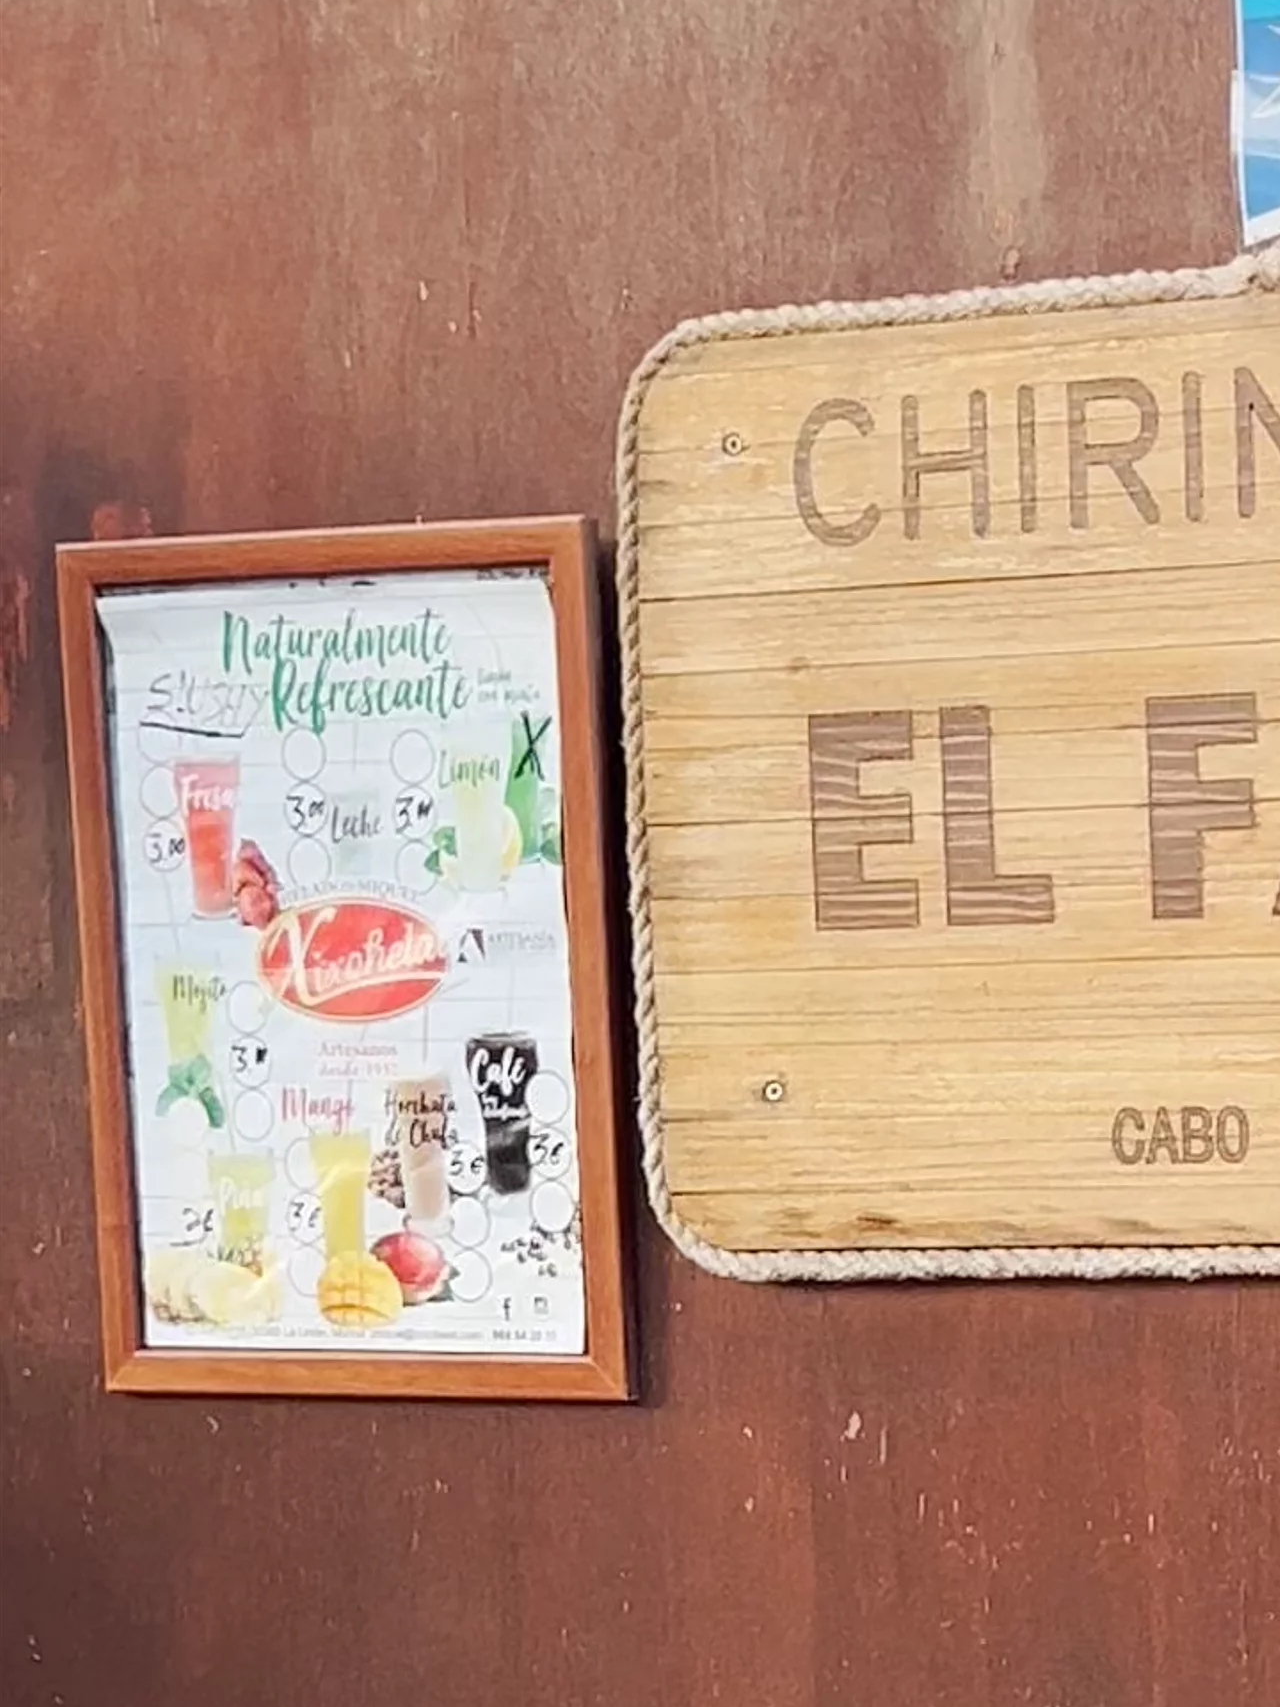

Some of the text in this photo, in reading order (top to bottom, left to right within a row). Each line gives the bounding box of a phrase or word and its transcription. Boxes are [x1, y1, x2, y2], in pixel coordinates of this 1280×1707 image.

[223, 607, 452, 675] Naturalmente
[272, 657, 473, 734] Refrescante
[331, 804, 383, 844] Leche
[808, 704, 1055, 932] EL
[1110, 1104, 1250, 1165] CABO
